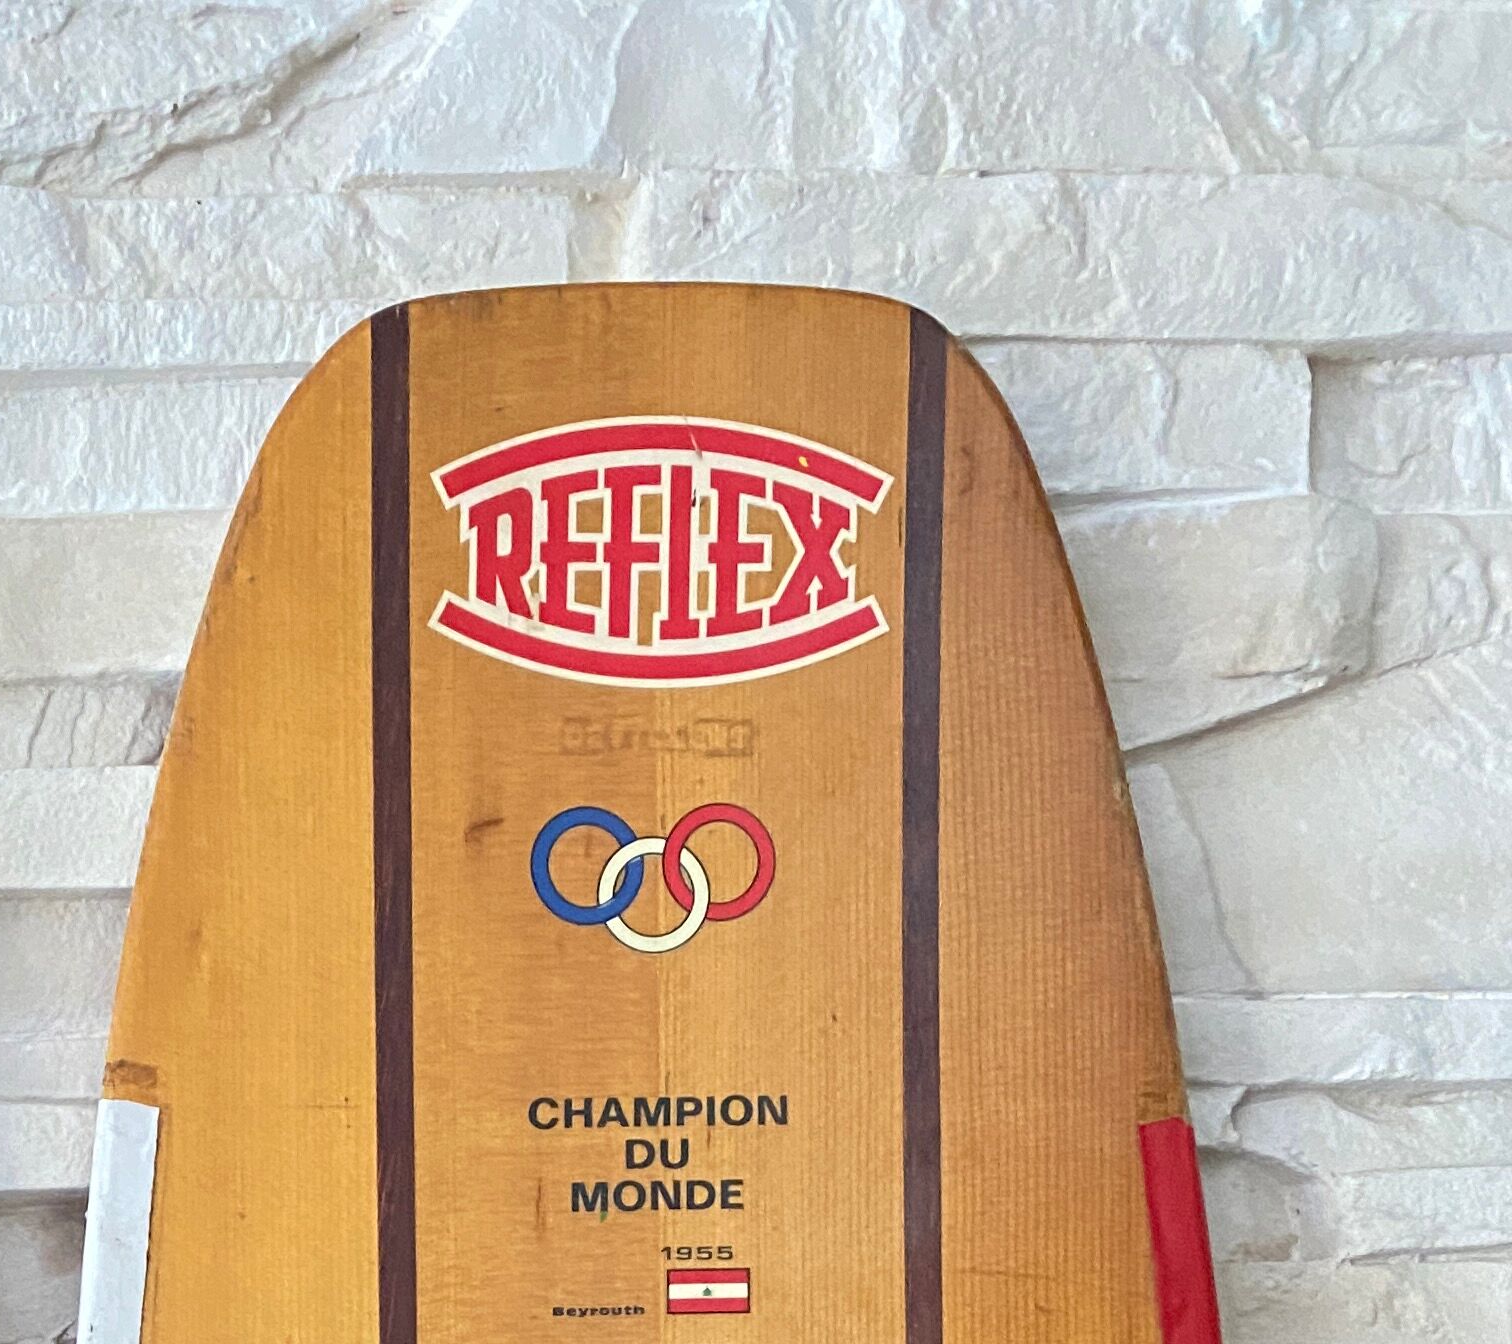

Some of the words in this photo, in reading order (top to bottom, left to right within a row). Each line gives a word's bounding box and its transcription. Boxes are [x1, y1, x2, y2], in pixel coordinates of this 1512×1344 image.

[466, 461, 854, 641] REFLEX
[527, 1095, 789, 1131] CHAMPION
[624, 1139, 690, 1169] DU
[570, 1180, 745, 1214] MONDE
[661, 1246, 734, 1261] 1955
[552, 1305, 645, 1317] Beyrouth
